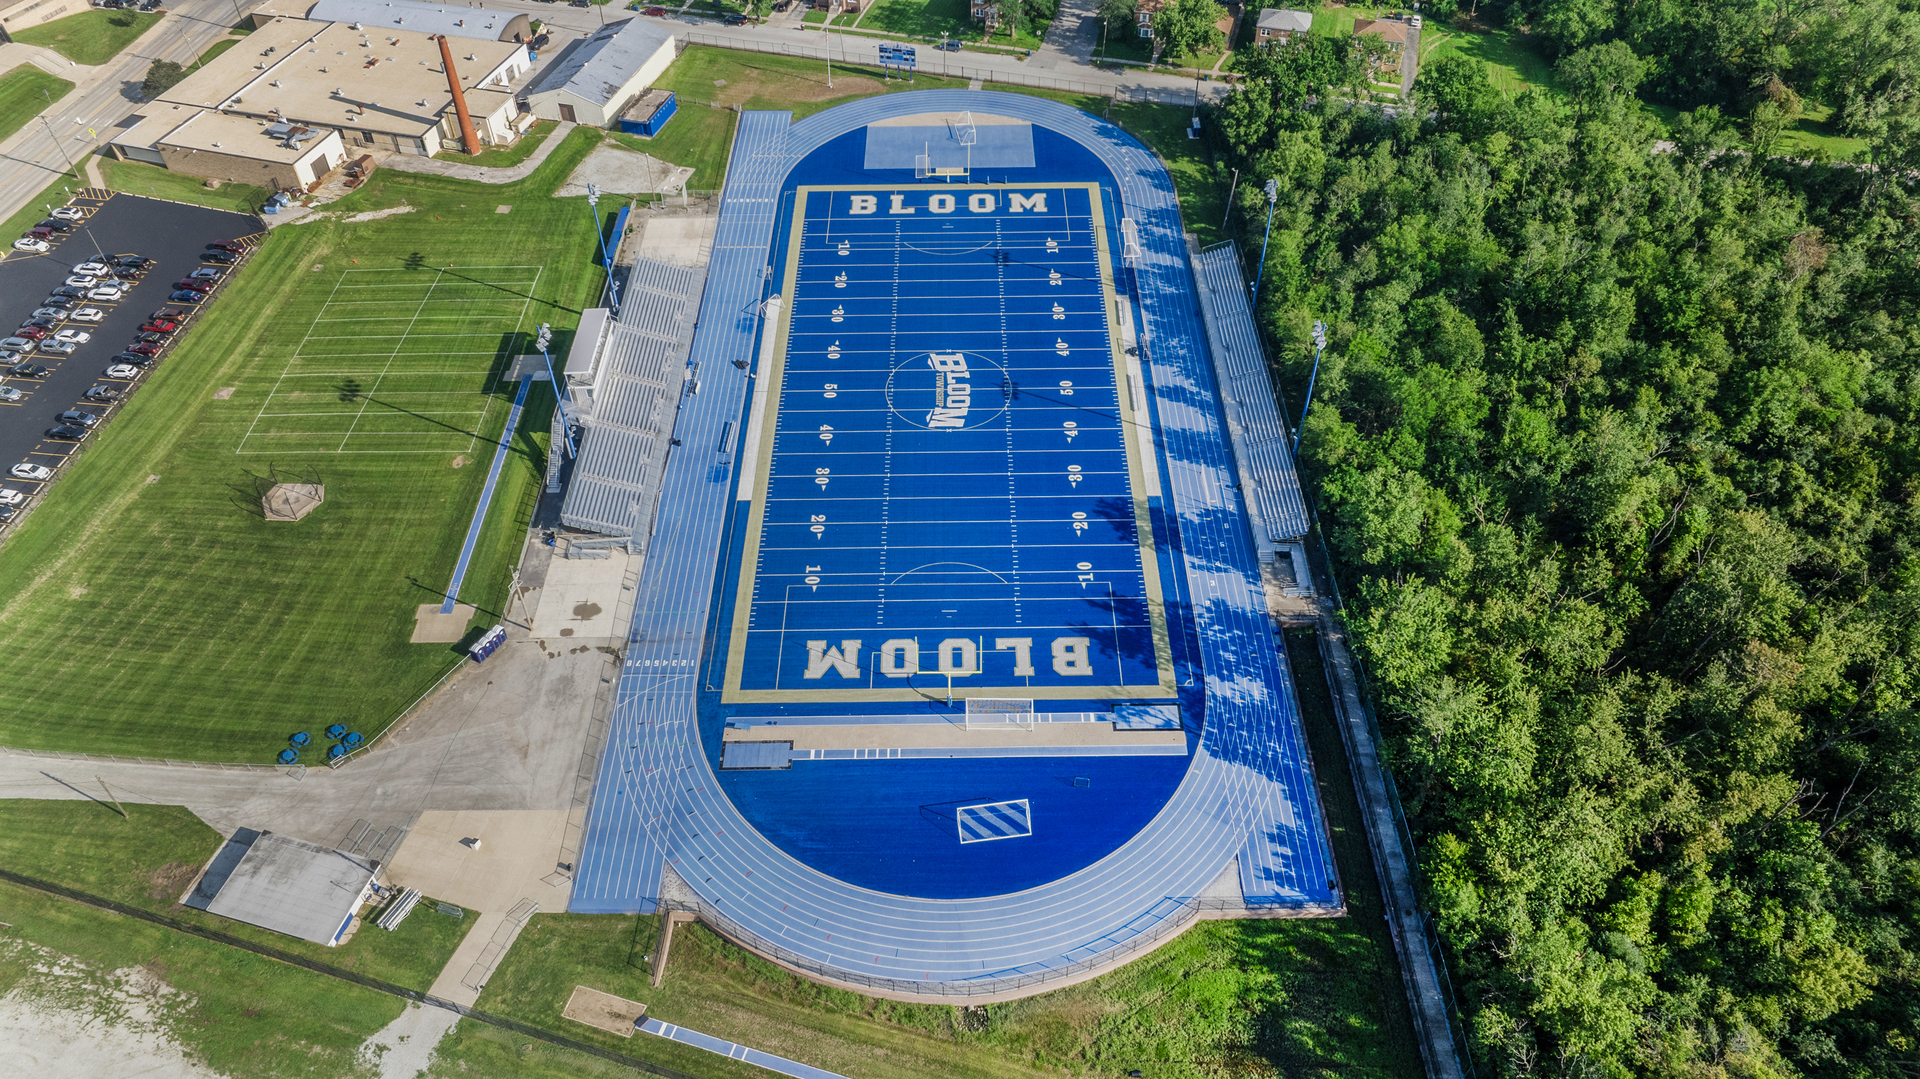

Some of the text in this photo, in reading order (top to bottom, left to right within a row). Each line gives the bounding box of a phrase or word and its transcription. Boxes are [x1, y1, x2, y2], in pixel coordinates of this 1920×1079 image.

[849, 192, 1048, 215] BLOOM
[838, 243, 850, 256] 10
[1045, 241, 1059, 254] 10
[834, 275, 848, 288] 20
[1048, 272, 1062, 286] 20
[831, 309, 845, 323] 30
[1051, 306, 1066, 320] 30
[827, 345, 842, 359] 40
[1055, 342, 1070, 357] 40
[823, 383, 838, 398] 50
[926, 353, 971, 428] BLOOM
[1059, 380, 1074, 396] 50
[819, 424, 834, 440] 40
[1063, 421, 1078, 437] 40
[814, 467, 830, 485] 30
[1067, 464, 1083, 482] 30
[810, 514, 827, 533] 20
[1071, 511, 1089, 530] 20
[804, 565, 822, 585] 10
[1076, 561, 1094, 581] 10
[803, 637, 1093, 679] BLOOM
